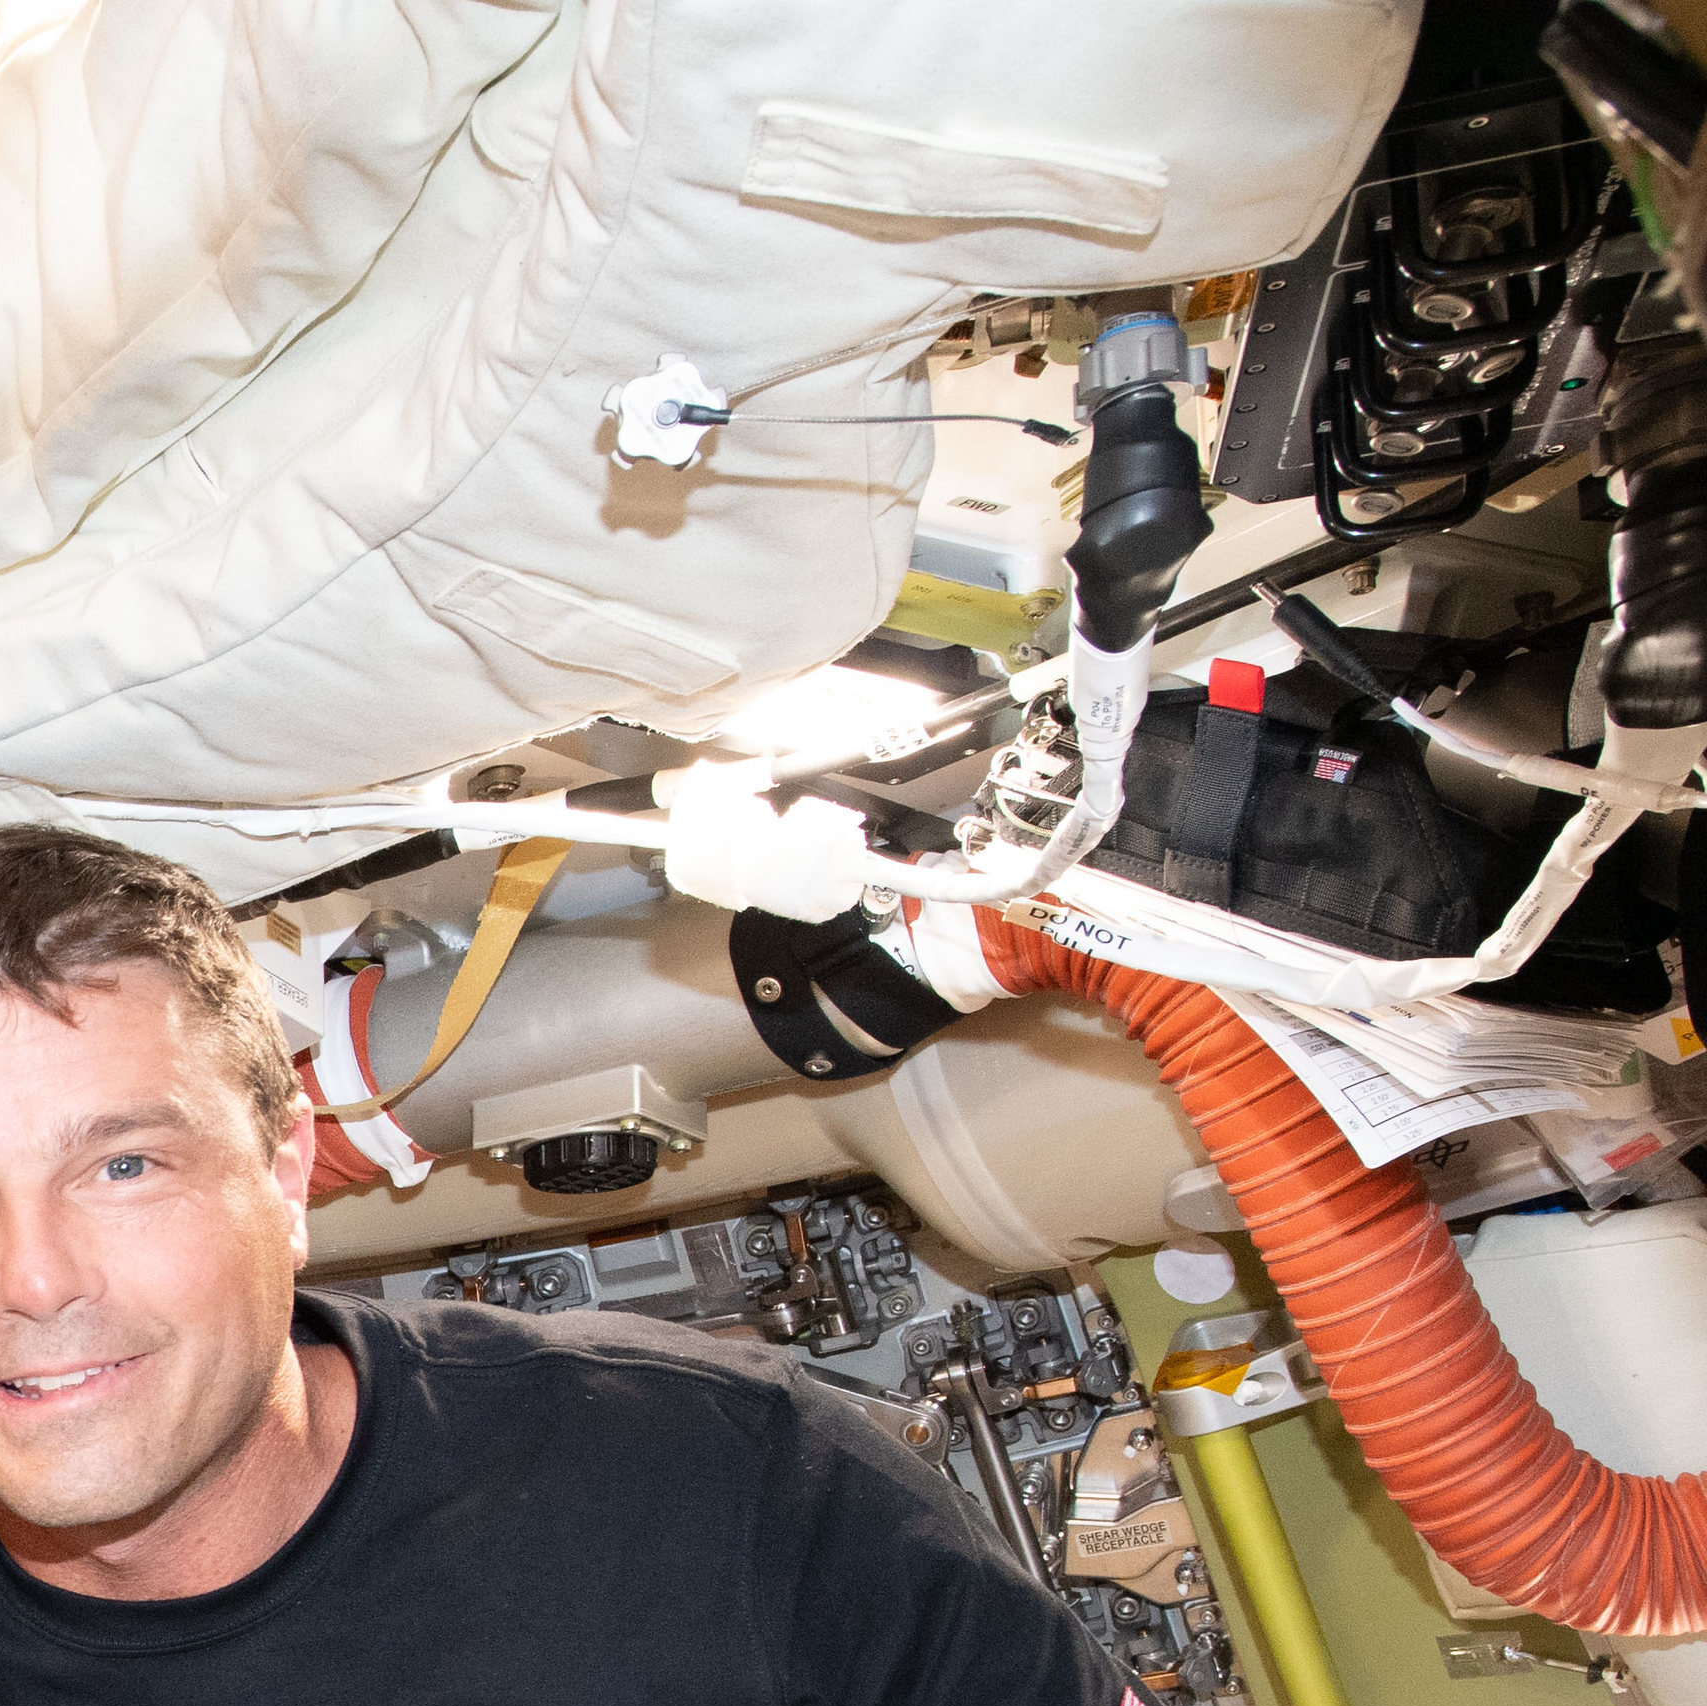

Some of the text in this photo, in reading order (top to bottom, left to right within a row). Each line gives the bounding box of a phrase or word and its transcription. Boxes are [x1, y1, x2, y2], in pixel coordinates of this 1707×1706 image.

[960, 499, 998, 512] FWD
[1590, 807, 1612, 838] POWER
[1029, 906, 1132, 950] DO NOT
[1078, 1521, 1167, 1544] SHEAR WEDGE
[1086, 1532, 1166, 1555] RECEPTACLE
